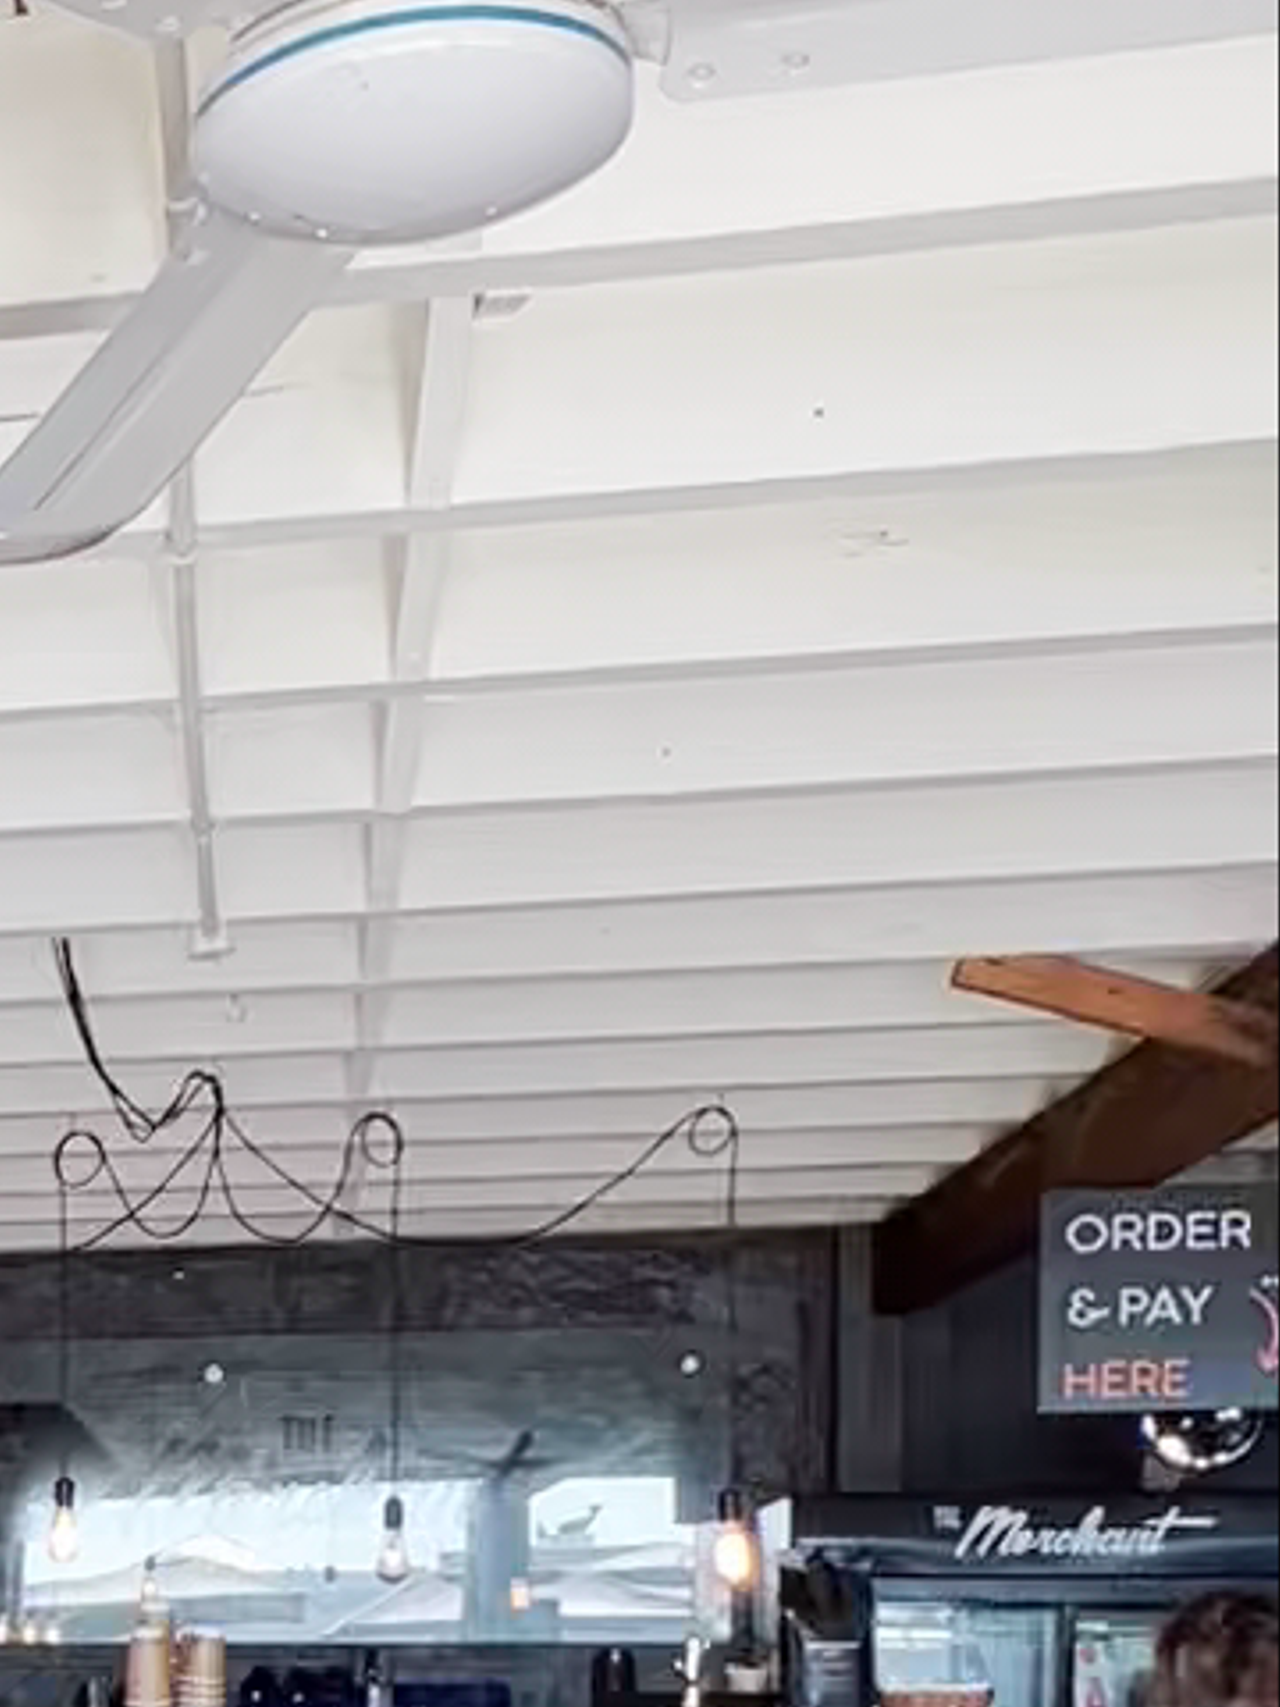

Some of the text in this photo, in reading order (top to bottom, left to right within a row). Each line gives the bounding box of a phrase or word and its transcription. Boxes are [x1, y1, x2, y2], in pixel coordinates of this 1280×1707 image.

[1065, 1210, 1252, 1254] ORDER
[1067, 1286, 1214, 1327] & PAY
[1064, 1359, 1190, 1400] HERE
[954, 1505, 1217, 1559] Merchant
